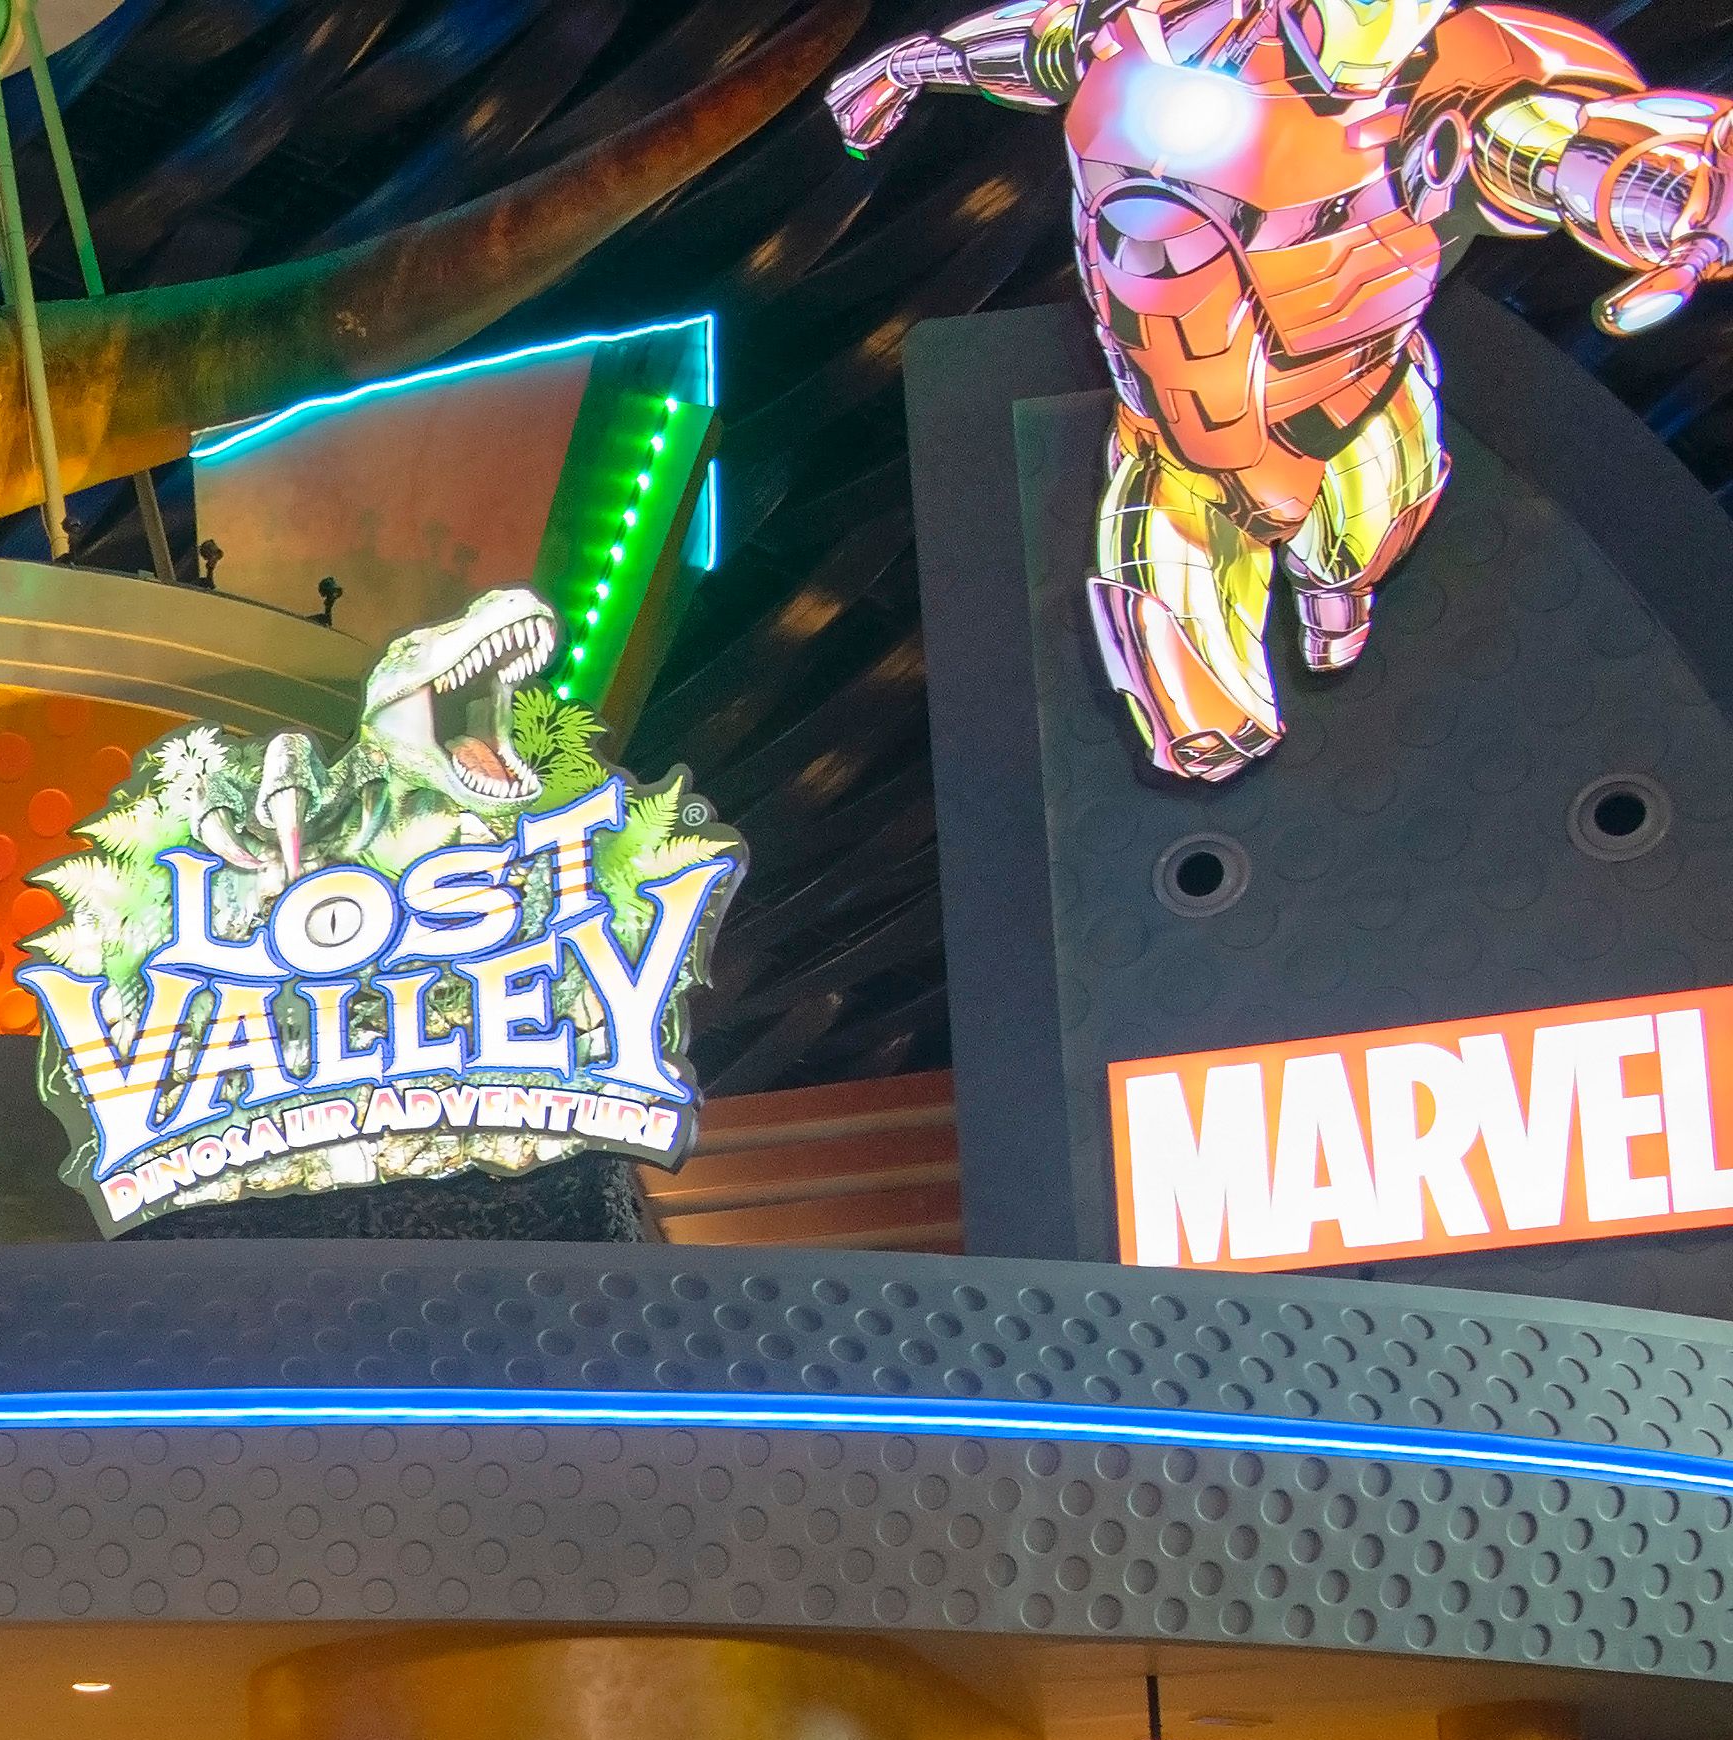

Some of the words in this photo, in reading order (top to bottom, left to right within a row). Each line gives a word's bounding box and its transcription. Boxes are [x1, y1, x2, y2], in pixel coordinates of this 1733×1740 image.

[145, 776, 625, 979] LOST
[17, 858, 738, 1180] VALLEY
[101, 1098, 361, 1222] DINOSAUR
[361, 1085, 679, 1152] ADVENTURE
[1125, 1008, 1733, 1267] MARVEL
